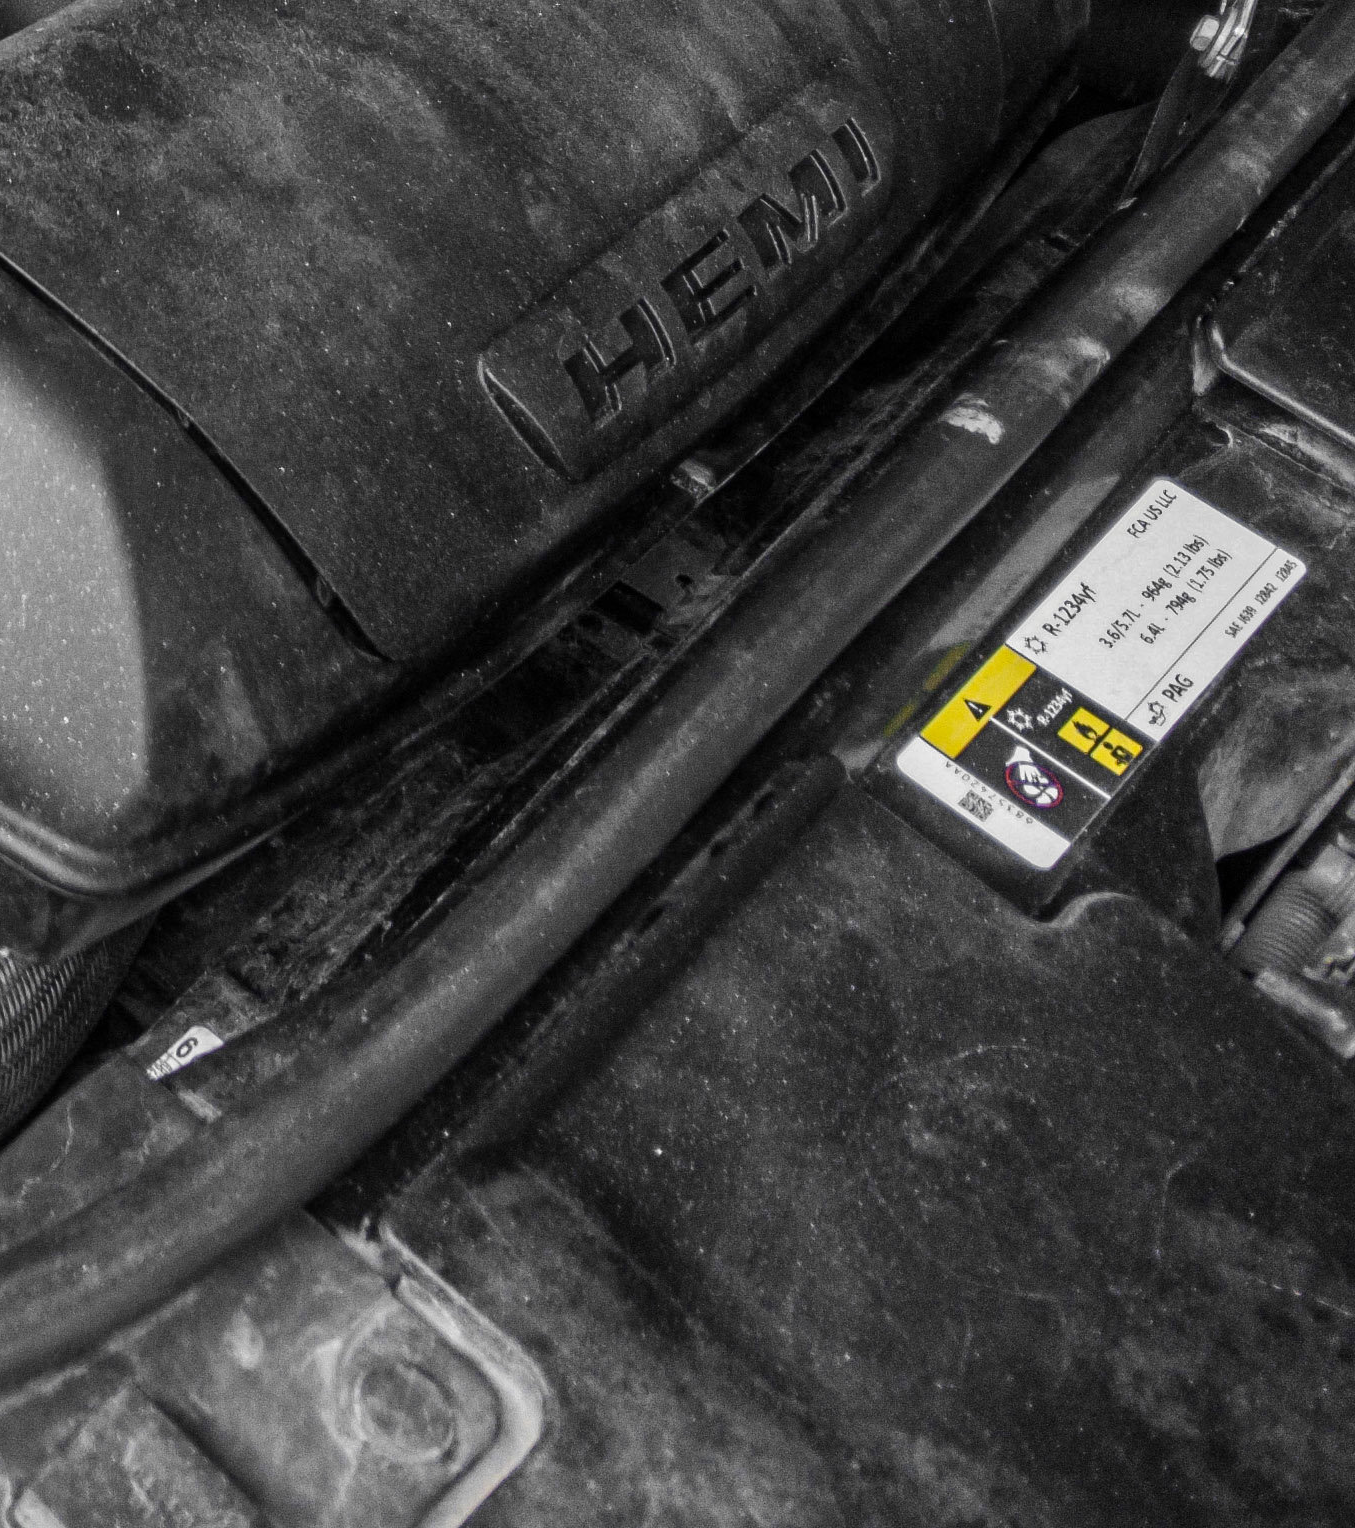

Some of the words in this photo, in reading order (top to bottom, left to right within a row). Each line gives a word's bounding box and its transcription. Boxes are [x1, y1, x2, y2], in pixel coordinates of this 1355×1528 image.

[560, 117, 882, 429] HEMI
[1126, 519, 1151, 539] FCA
[1143, 504, 1163, 521] US
[1154, 489, 1177, 509] LLC
[1141, 577, 1173, 602] 964g
[1162, 546, 1192, 579] (2.13
[1164, 591, 1197, 616] 794g
[1186, 565, 1215, 593] (1.75
[1041, 582, 1097, 637] R-1234yf
[1161, 673, 1194, 703] PAG
